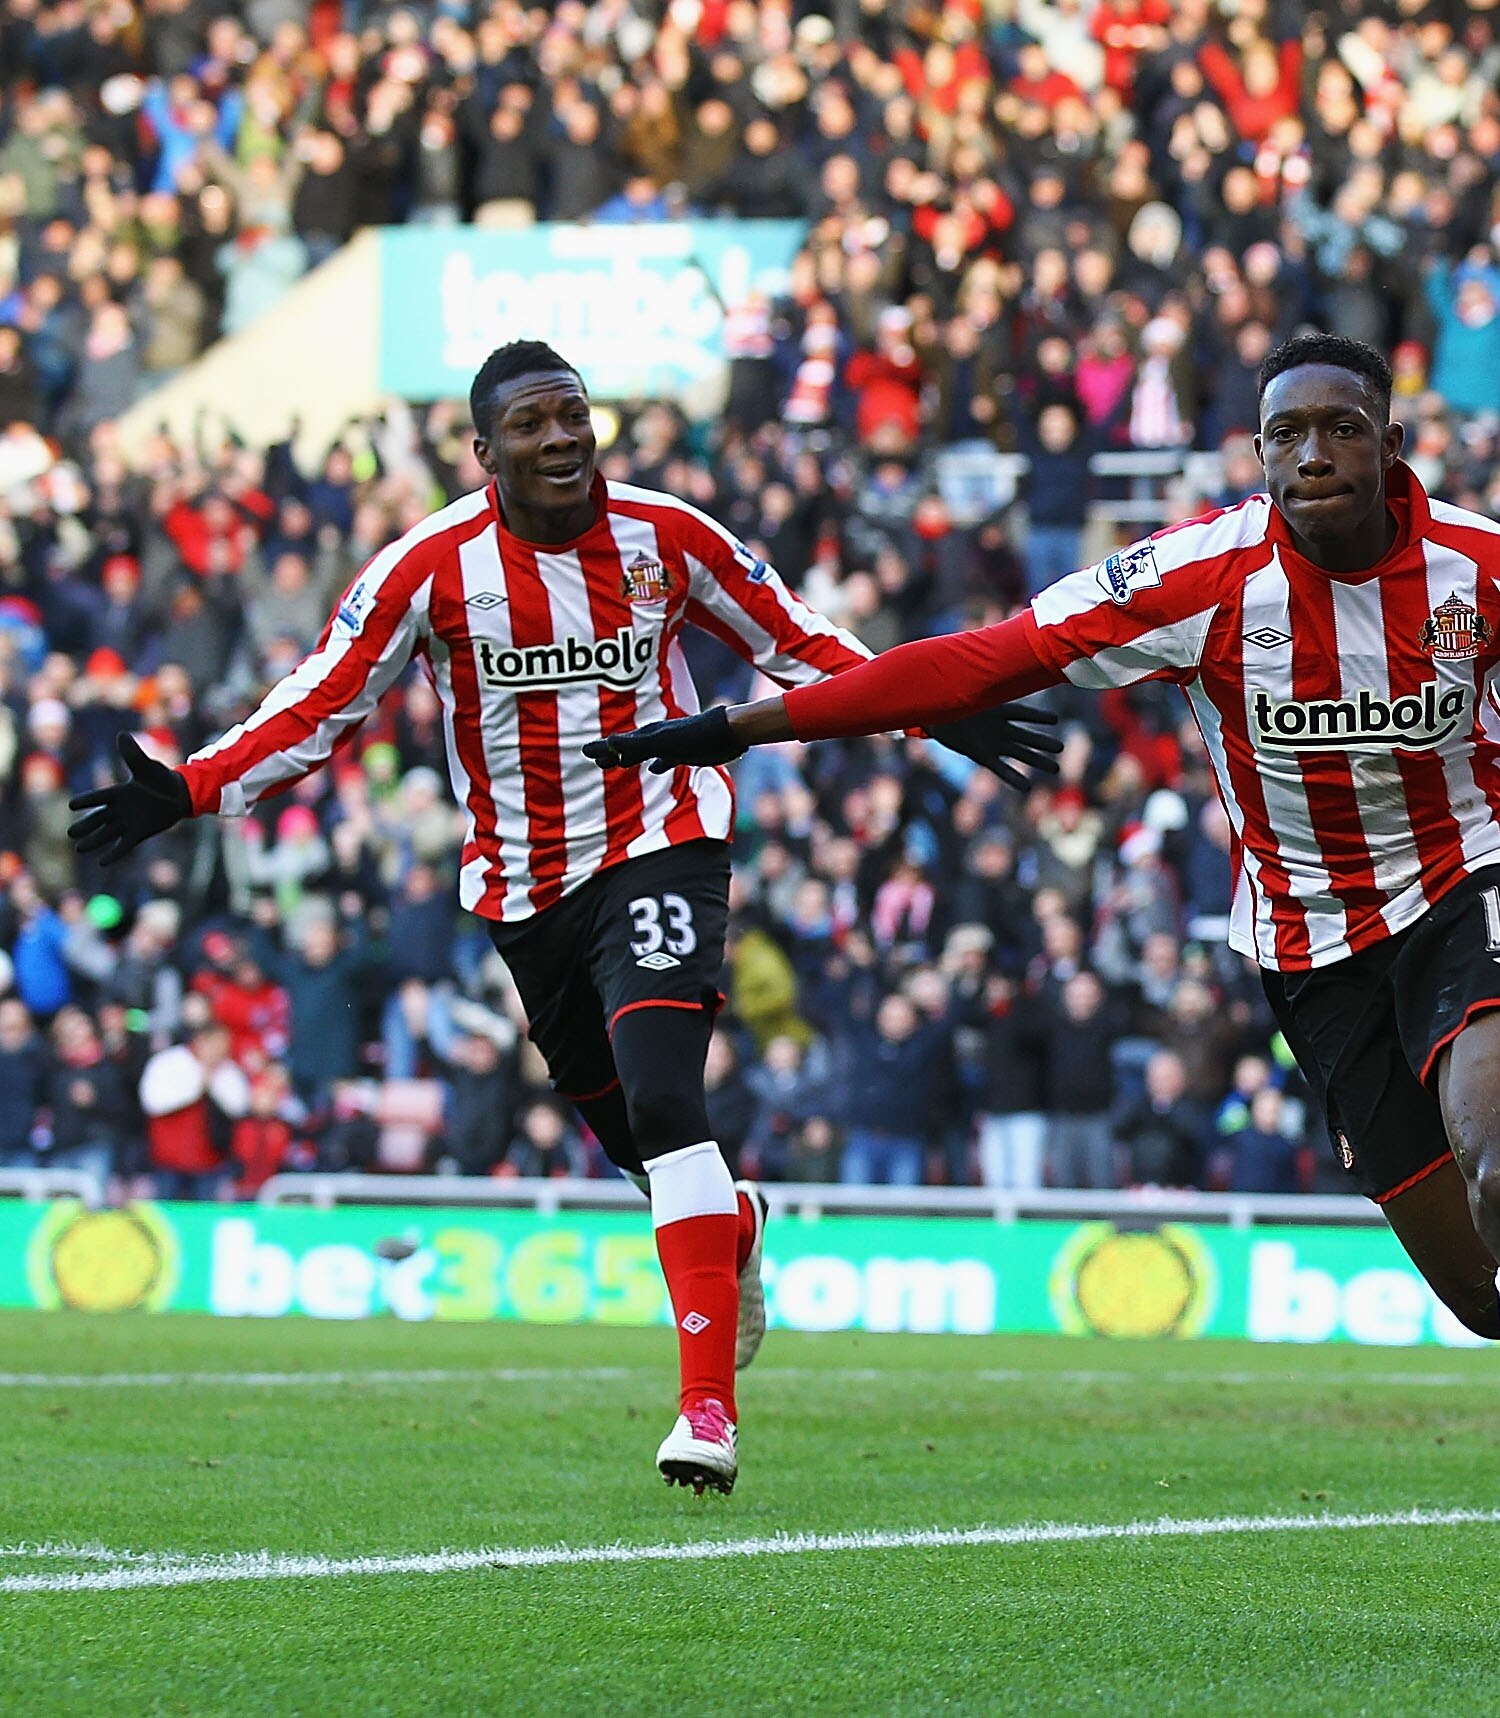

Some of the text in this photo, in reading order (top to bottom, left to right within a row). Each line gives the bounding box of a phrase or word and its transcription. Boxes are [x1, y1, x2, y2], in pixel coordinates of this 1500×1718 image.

[480, 631, 653, 677] tombola
[1255, 685, 1465, 735] tombola
[629, 893, 697, 956] 33
